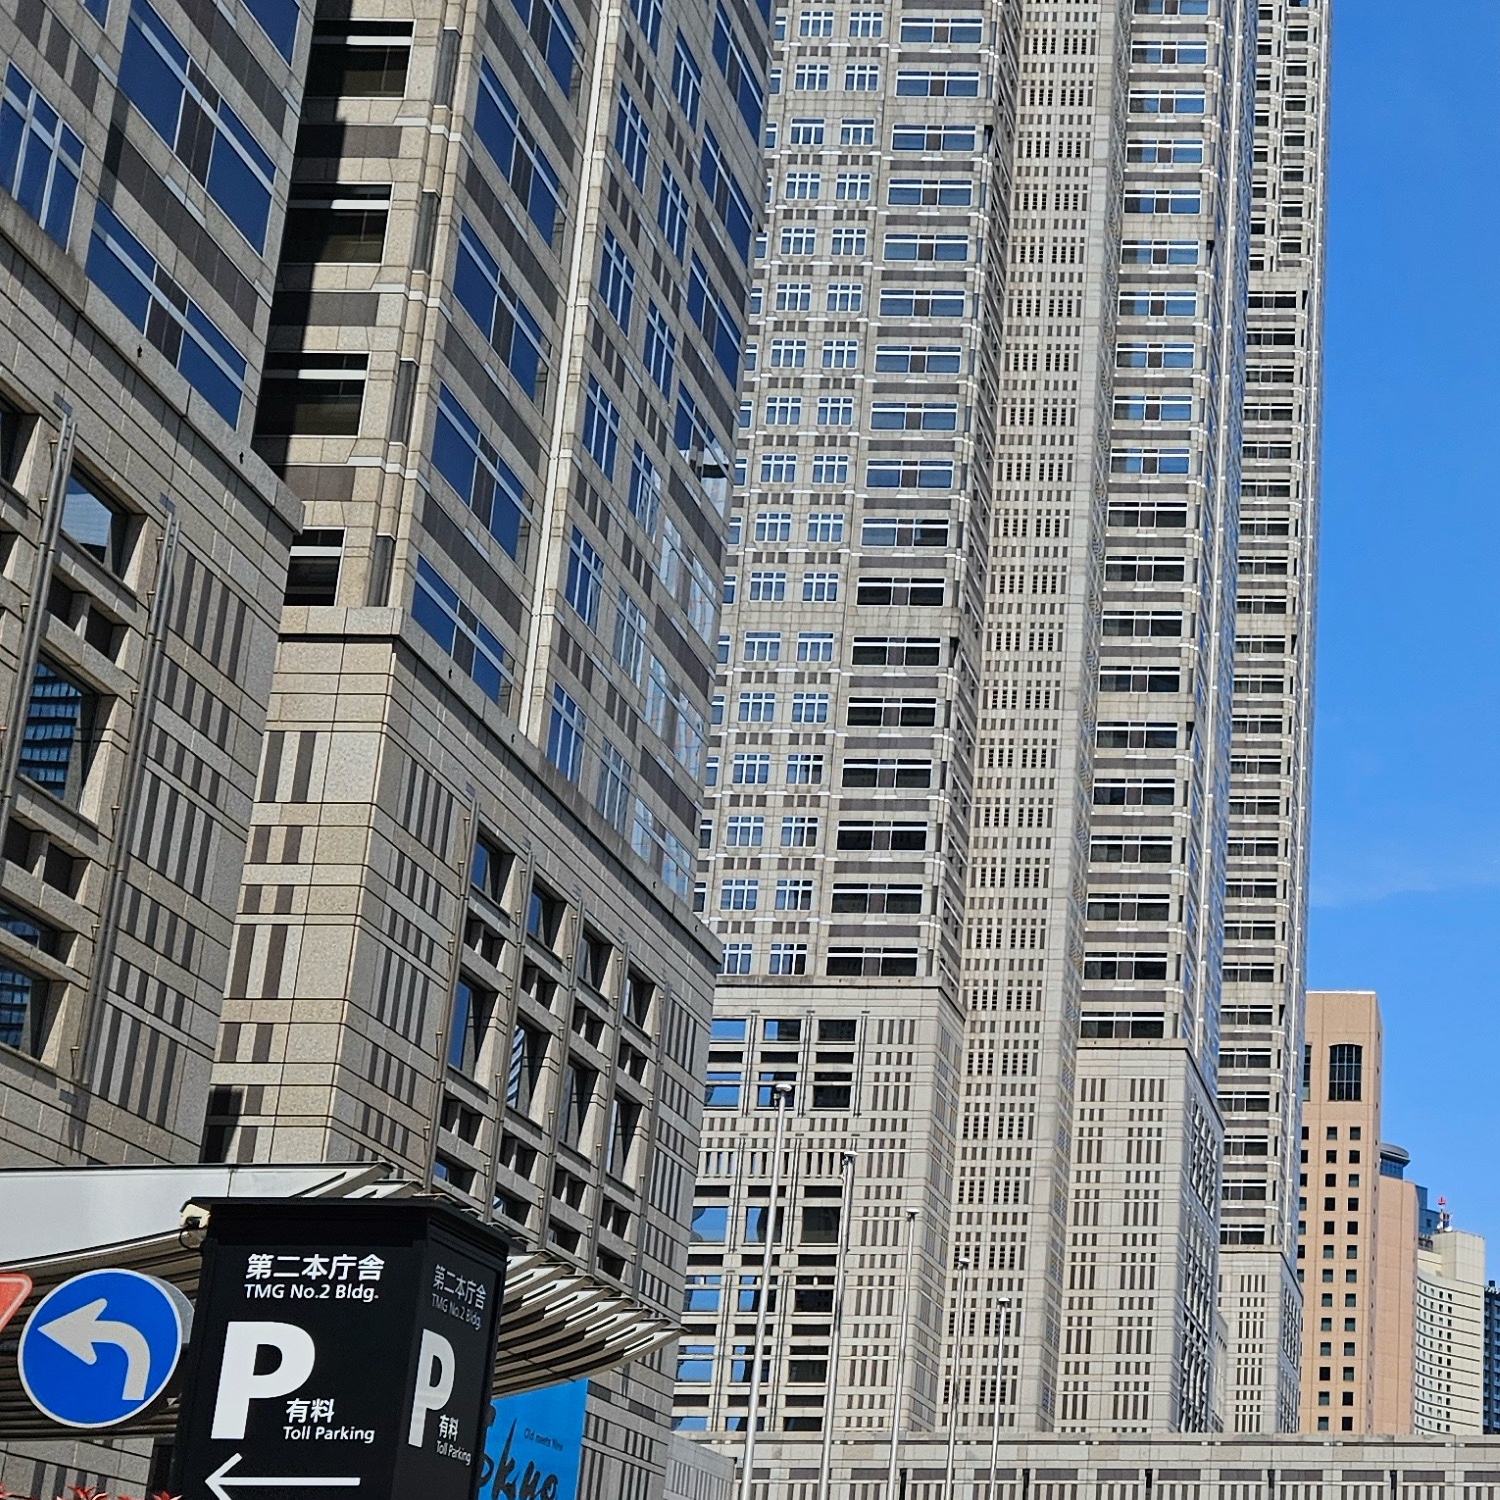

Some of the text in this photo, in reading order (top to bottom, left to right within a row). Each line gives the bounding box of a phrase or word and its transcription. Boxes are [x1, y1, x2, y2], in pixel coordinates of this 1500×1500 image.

[245, 1253, 385, 1281] 第二本庁舎
[244, 1283, 379, 1303] TMG No.2 Bldg.
[432, 1263, 487, 1310] 第二本庁舎
[430, 1293, 448, 1313] TMG
[449, 1303, 466, 1321] No.2
[211, 1321, 316, 1440] P
[408, 1328, 456, 1448] P
[285, 1398, 335, 1424] 有料
[283, 1426, 375, 1444] Toll Parking
[438, 1414, 459, 1442] 有料
[436, 1440, 472, 1466] Toll Parking
